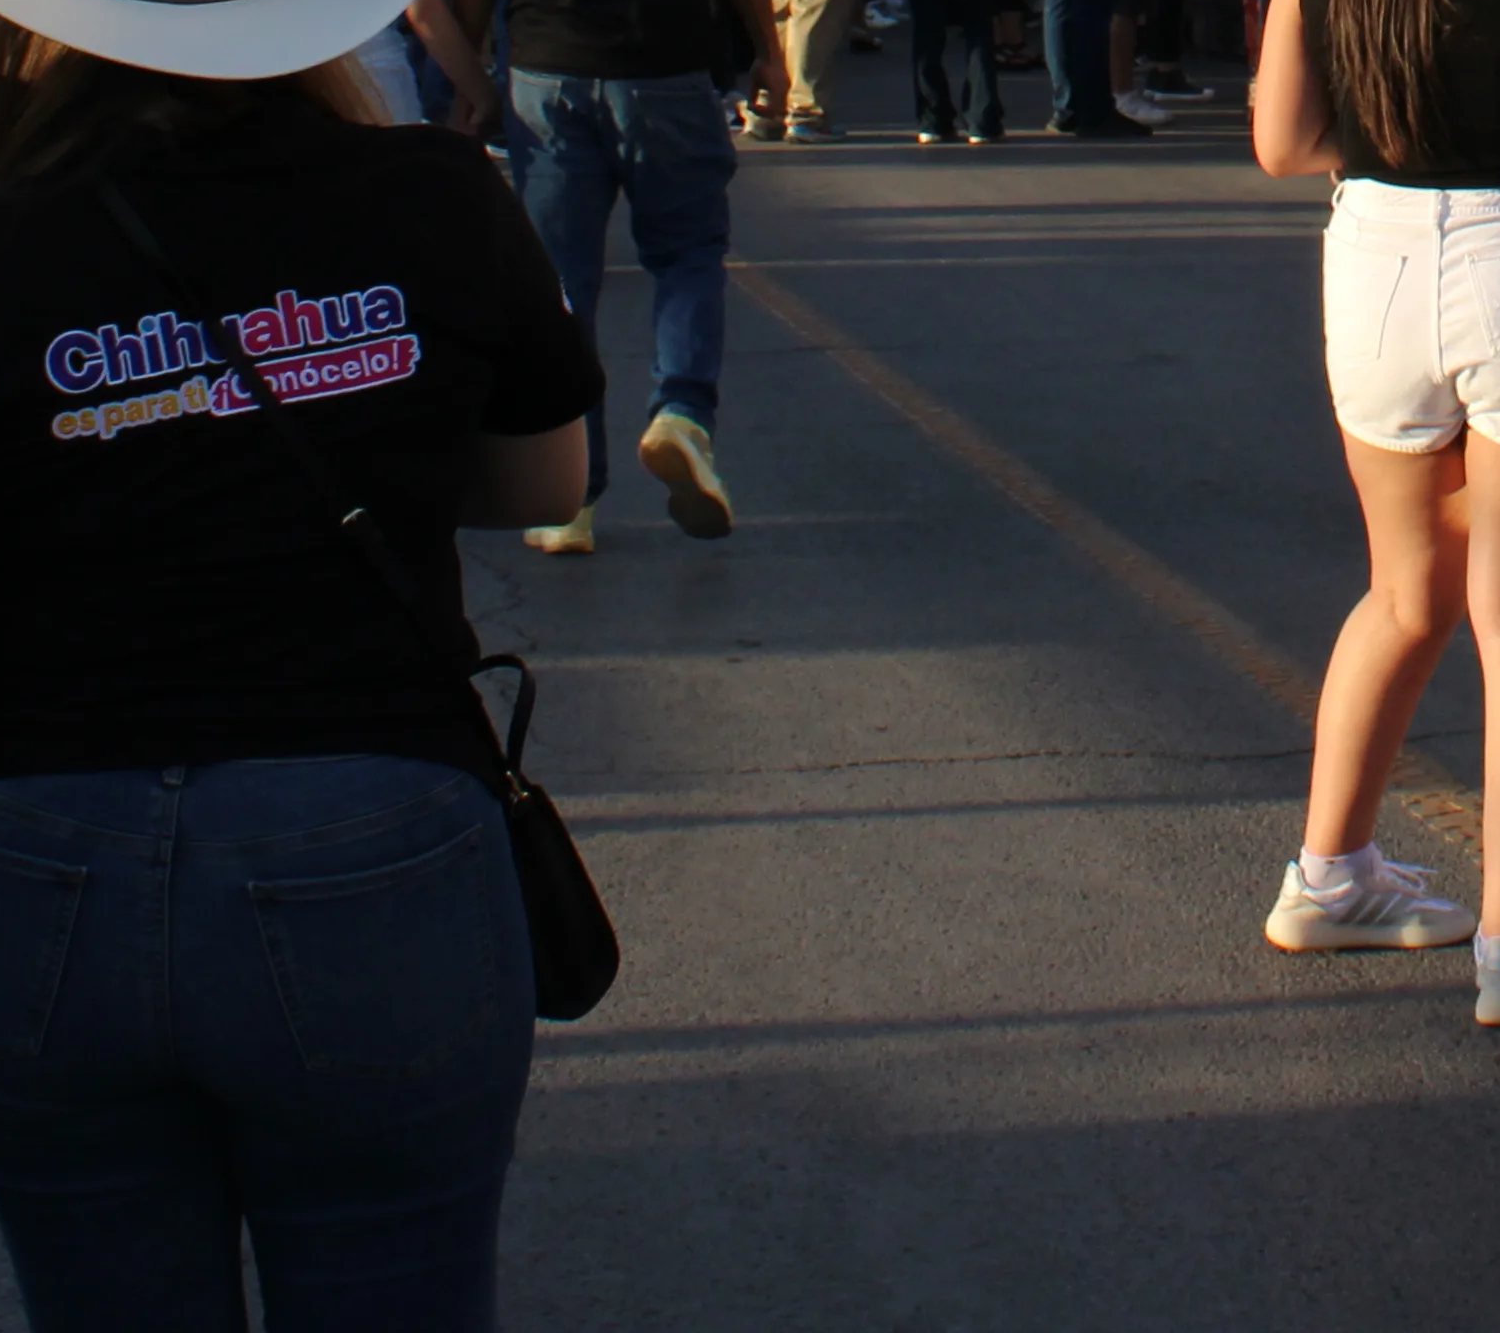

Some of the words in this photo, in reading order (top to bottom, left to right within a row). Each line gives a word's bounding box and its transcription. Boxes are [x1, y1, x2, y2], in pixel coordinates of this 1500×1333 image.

[52, 407, 98, 439] es
[98, 385, 184, 439] para
[182, 375, 210, 414] ti
